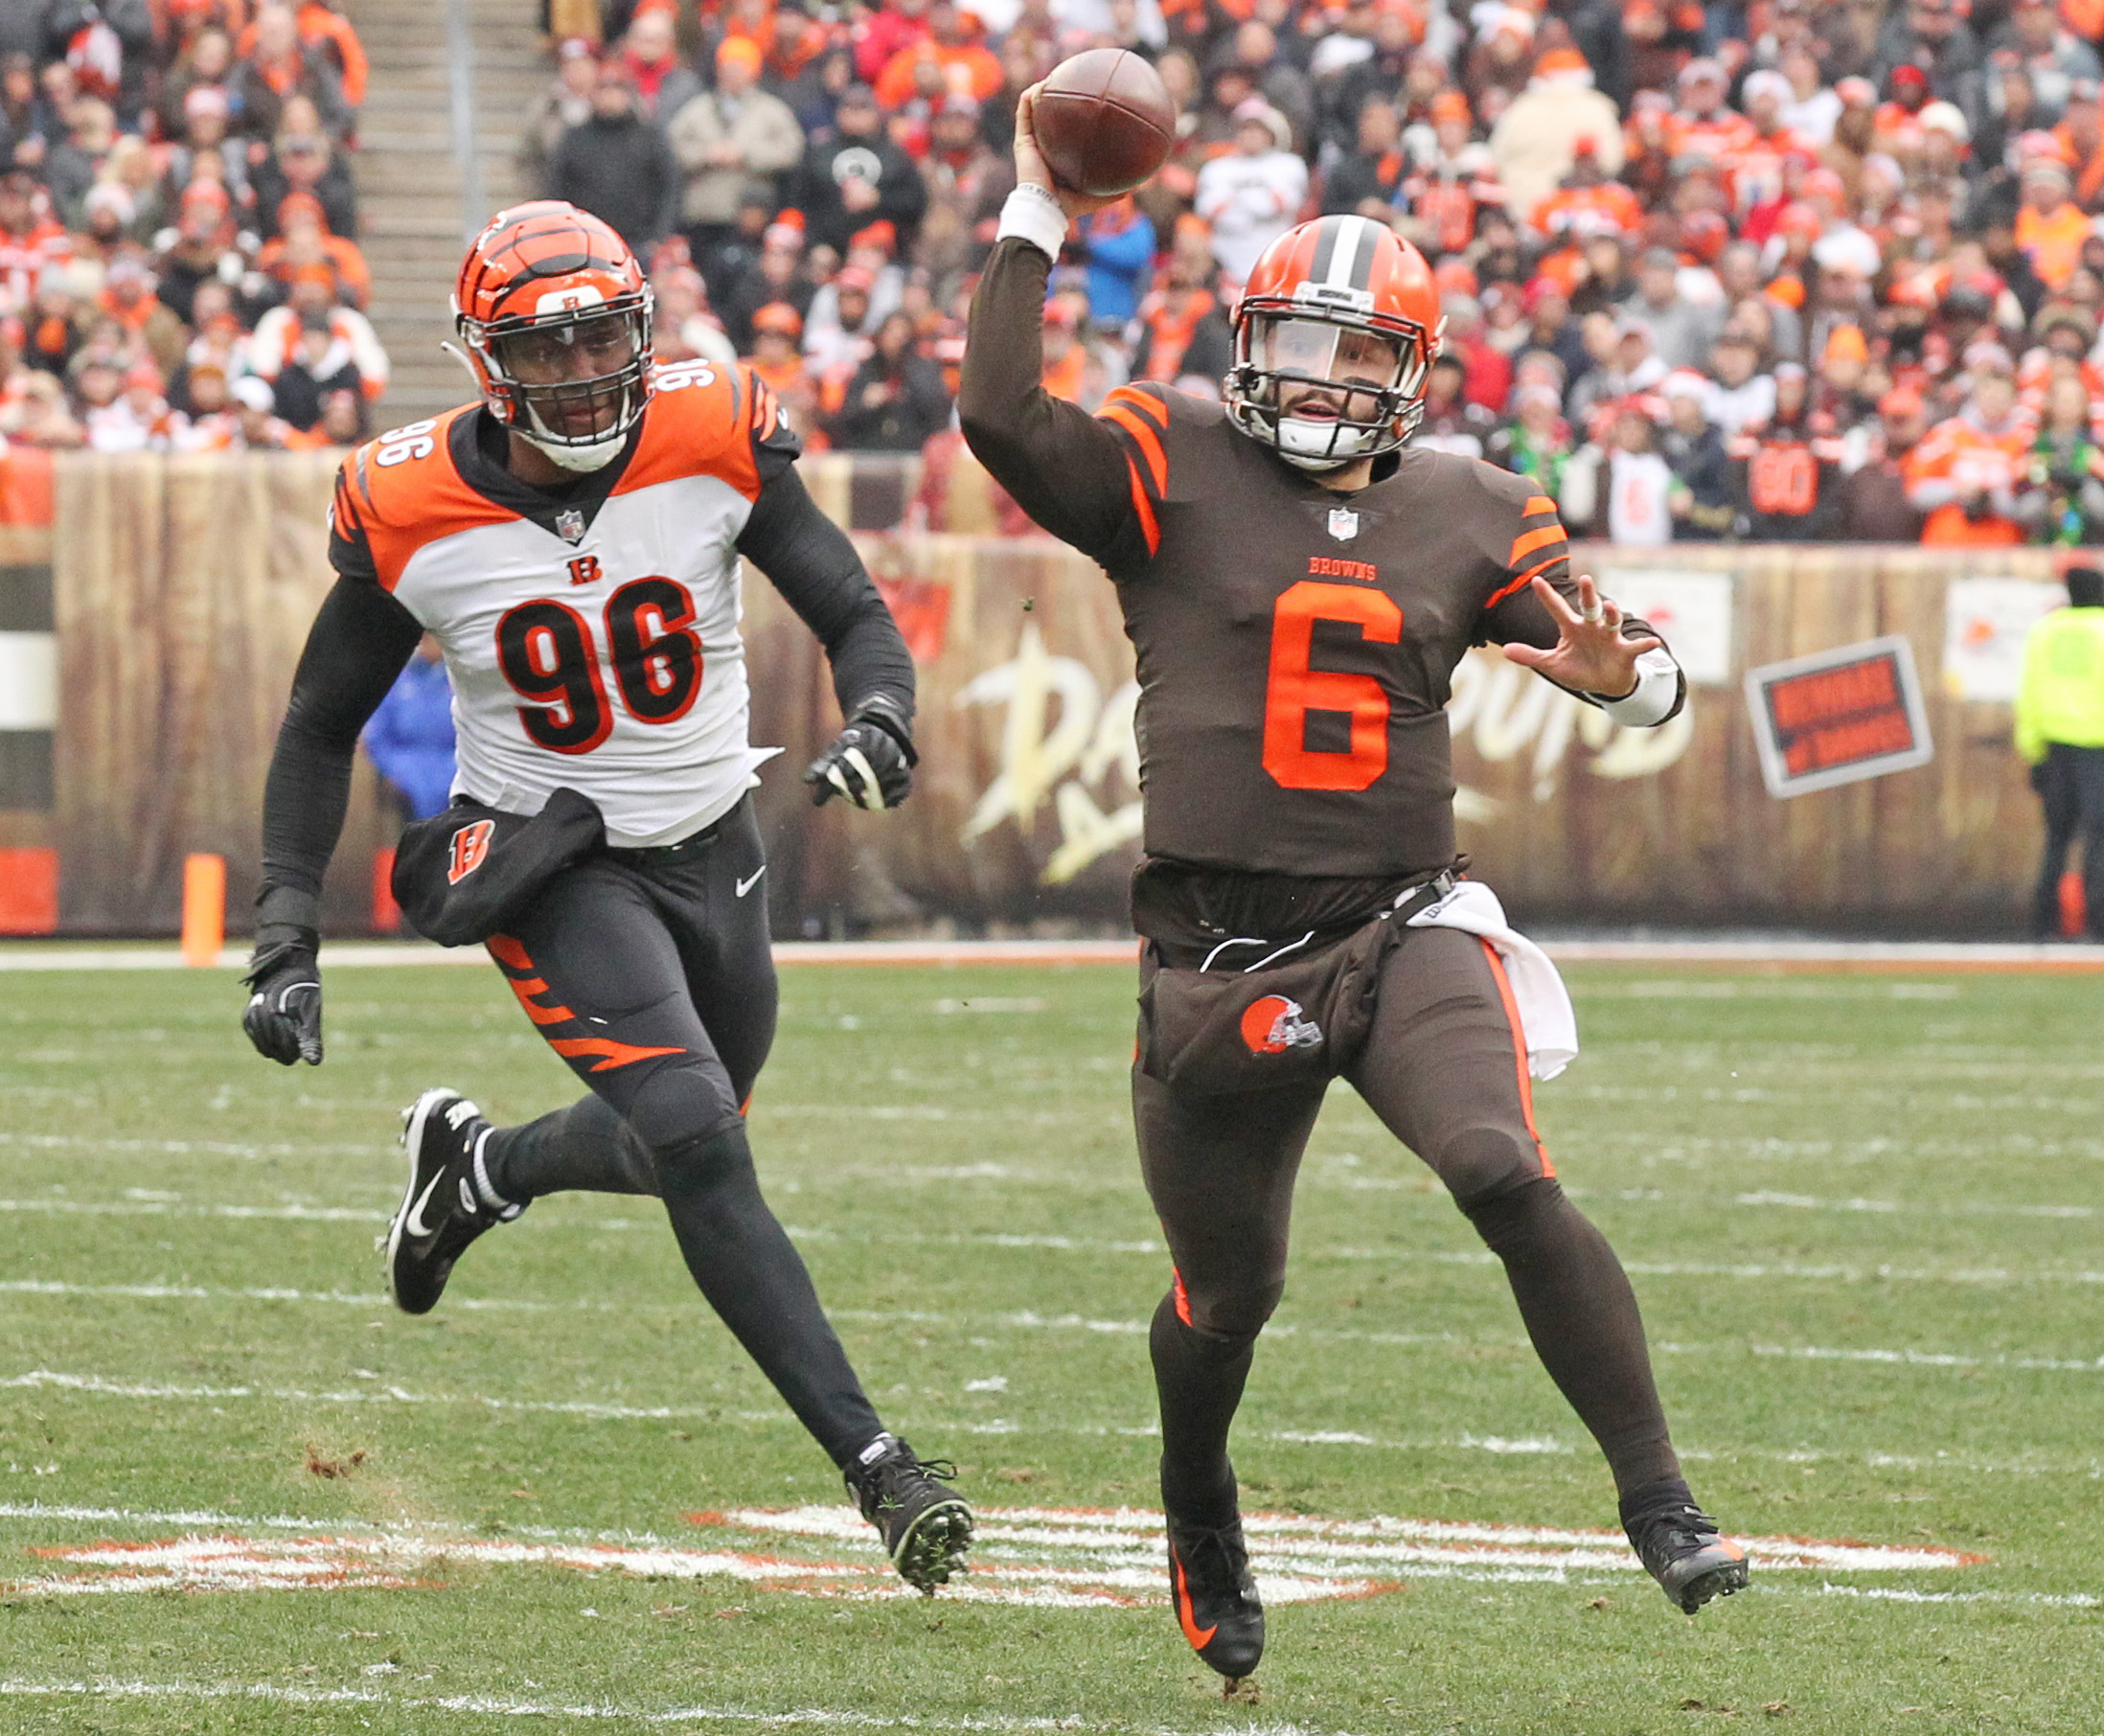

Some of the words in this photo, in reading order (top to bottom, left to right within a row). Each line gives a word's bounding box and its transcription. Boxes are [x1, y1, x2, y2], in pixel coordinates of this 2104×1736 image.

[376, 419, 438, 468] 96
[566, 555, 603, 586] B
[1308, 557, 1377, 582] BROWNS
[494, 575, 704, 754] 96
[1262, 580, 1404, 791] 6
[446, 818, 496, 886] B
